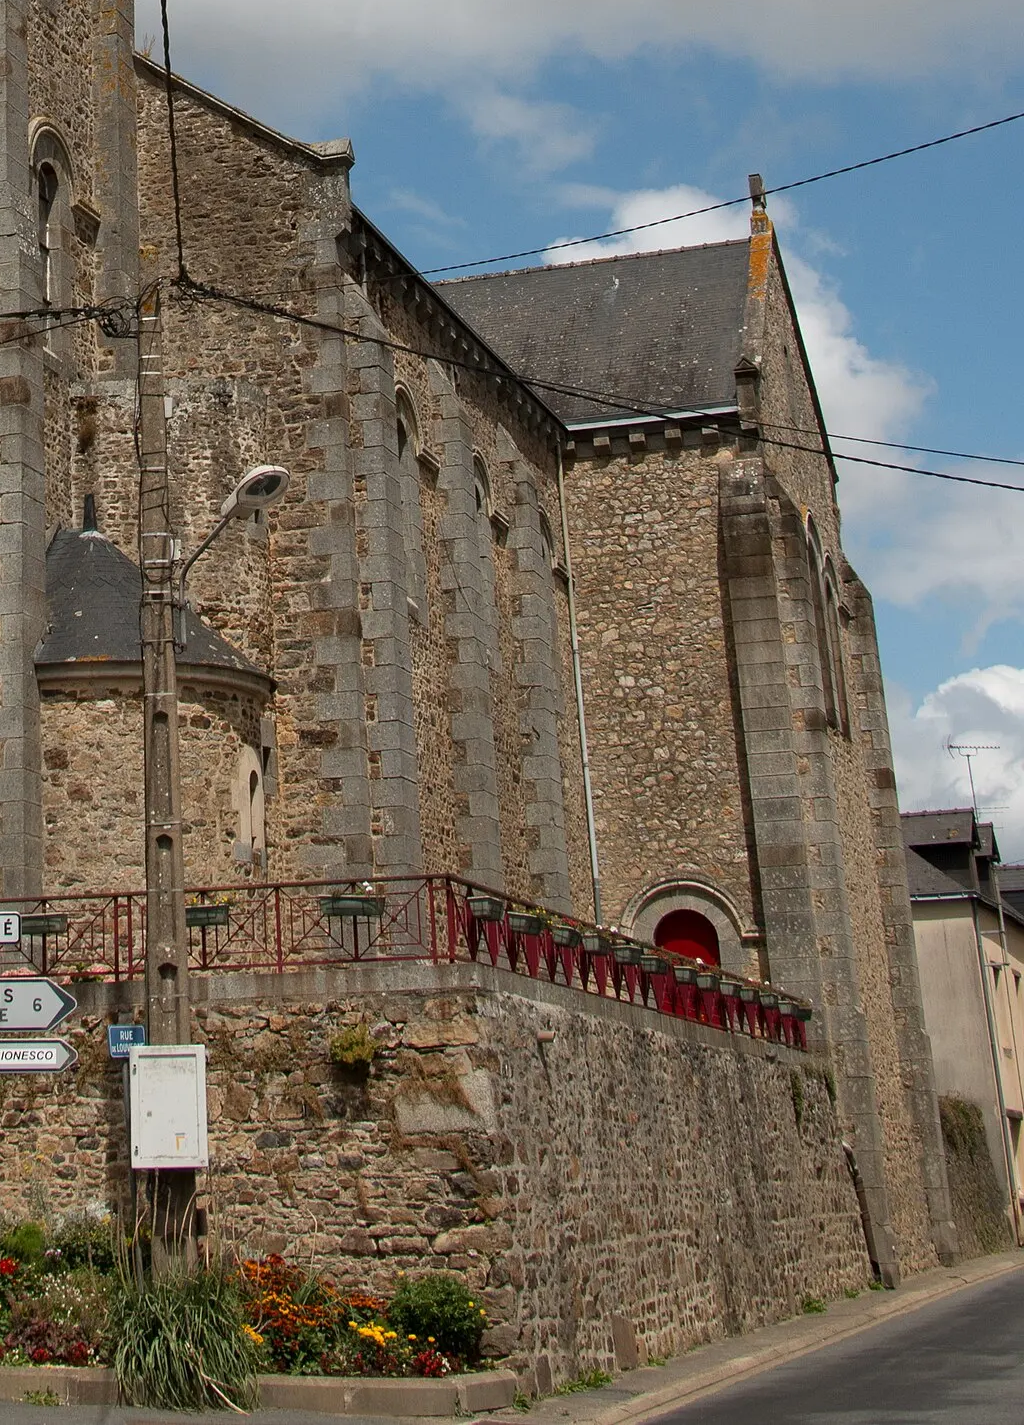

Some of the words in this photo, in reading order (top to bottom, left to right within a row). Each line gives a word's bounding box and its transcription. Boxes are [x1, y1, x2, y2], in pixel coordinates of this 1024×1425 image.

[32, 998, 42, 1012] 6
[120, 1030, 133, 1041] RUE
[0, 1050, 54, 1061] IONESCO
